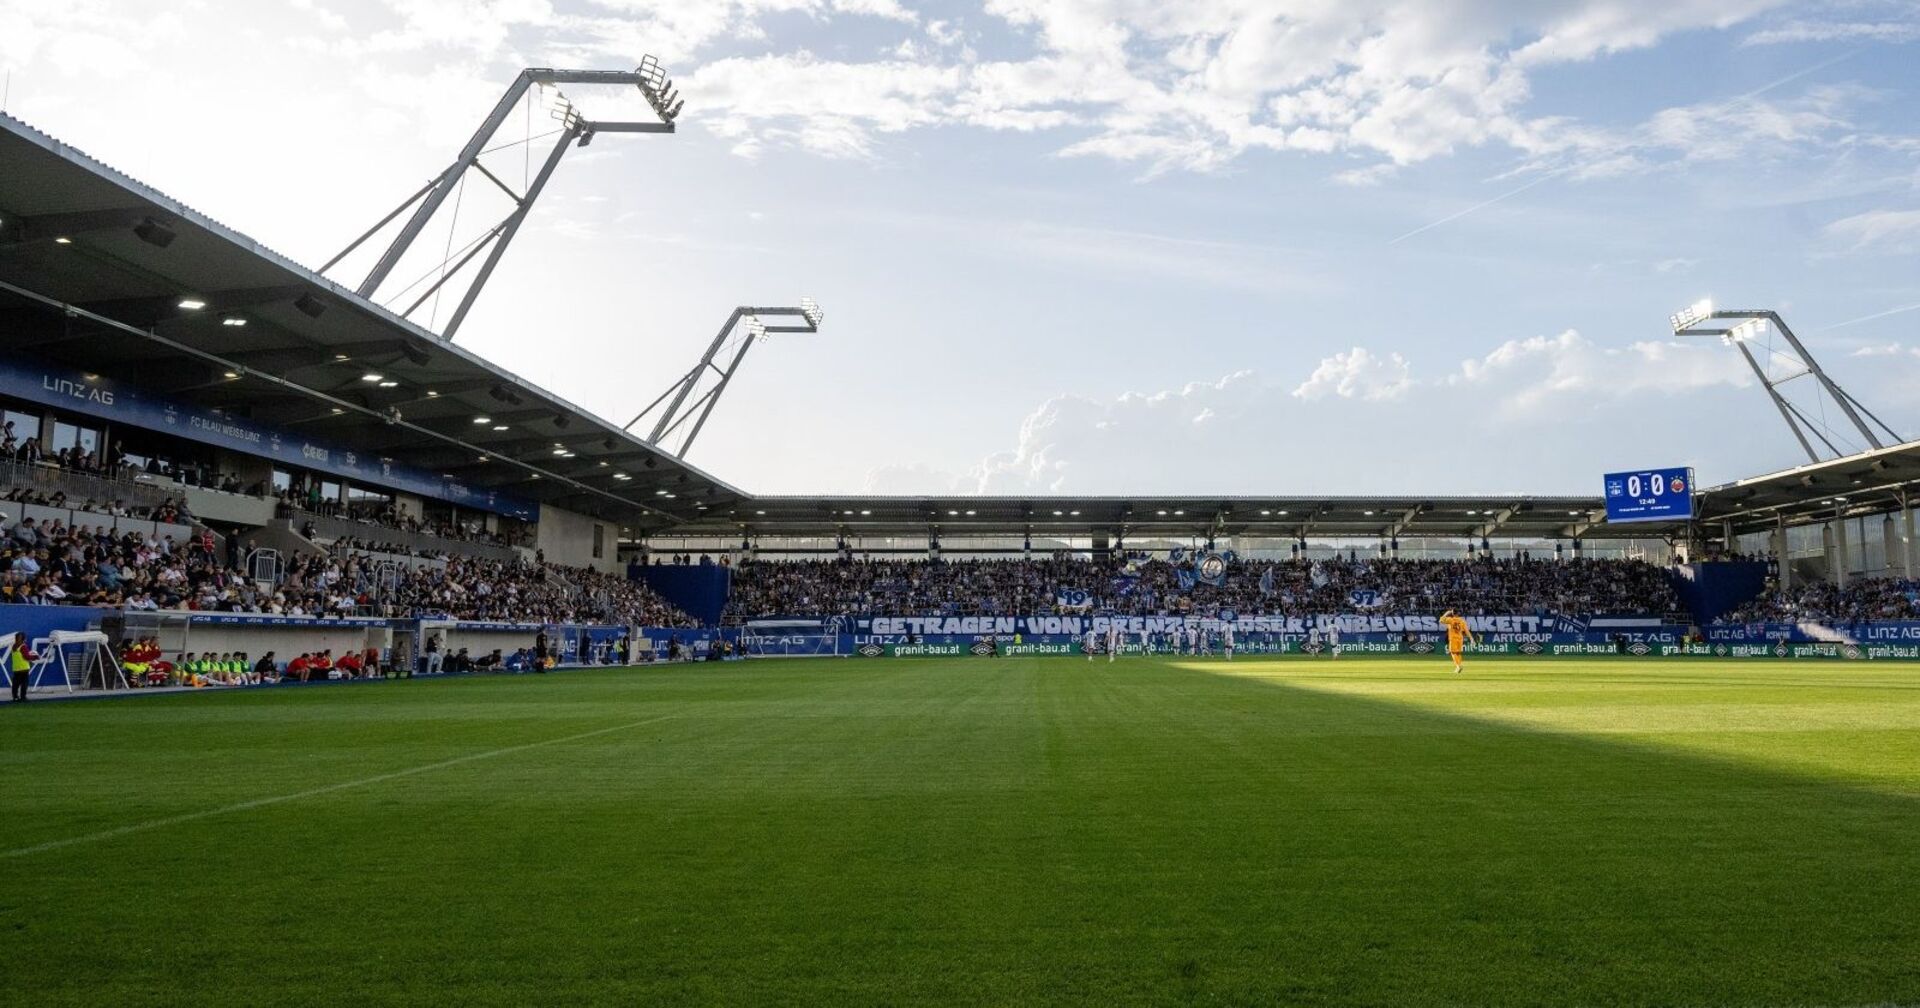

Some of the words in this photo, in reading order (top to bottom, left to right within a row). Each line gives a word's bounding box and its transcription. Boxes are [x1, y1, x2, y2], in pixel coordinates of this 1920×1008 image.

[43, 375, 85, 399] LINZ
[88, 388, 114, 406] AG
[190, 415, 201, 428] FC
[202, 418, 220, 433] BLAU
[222, 424, 244, 439] WEISS
[244, 430, 260, 443] LINZ
[1062, 590, 1085, 606] 19
[1350, 590, 1376, 606] 97
[871, 617, 1015, 635] GETRAGEN
[1026, 616, 1081, 635] VON
[854, 635, 894, 644] LINZ
[1492, 632, 1553, 643] ARTGROUP
[1731, 630, 1745, 640] AG
[1868, 627, 1898, 639] LINZ
[894, 644, 960, 657] granit-bau.at
[1005, 643, 1071, 656] granit-bau.at
[1336, 641, 1400, 654] granit-bau.at
[1553, 642, 1617, 655] granit-bau.at
[1867, 644, 1919, 659] granit-bau.at
